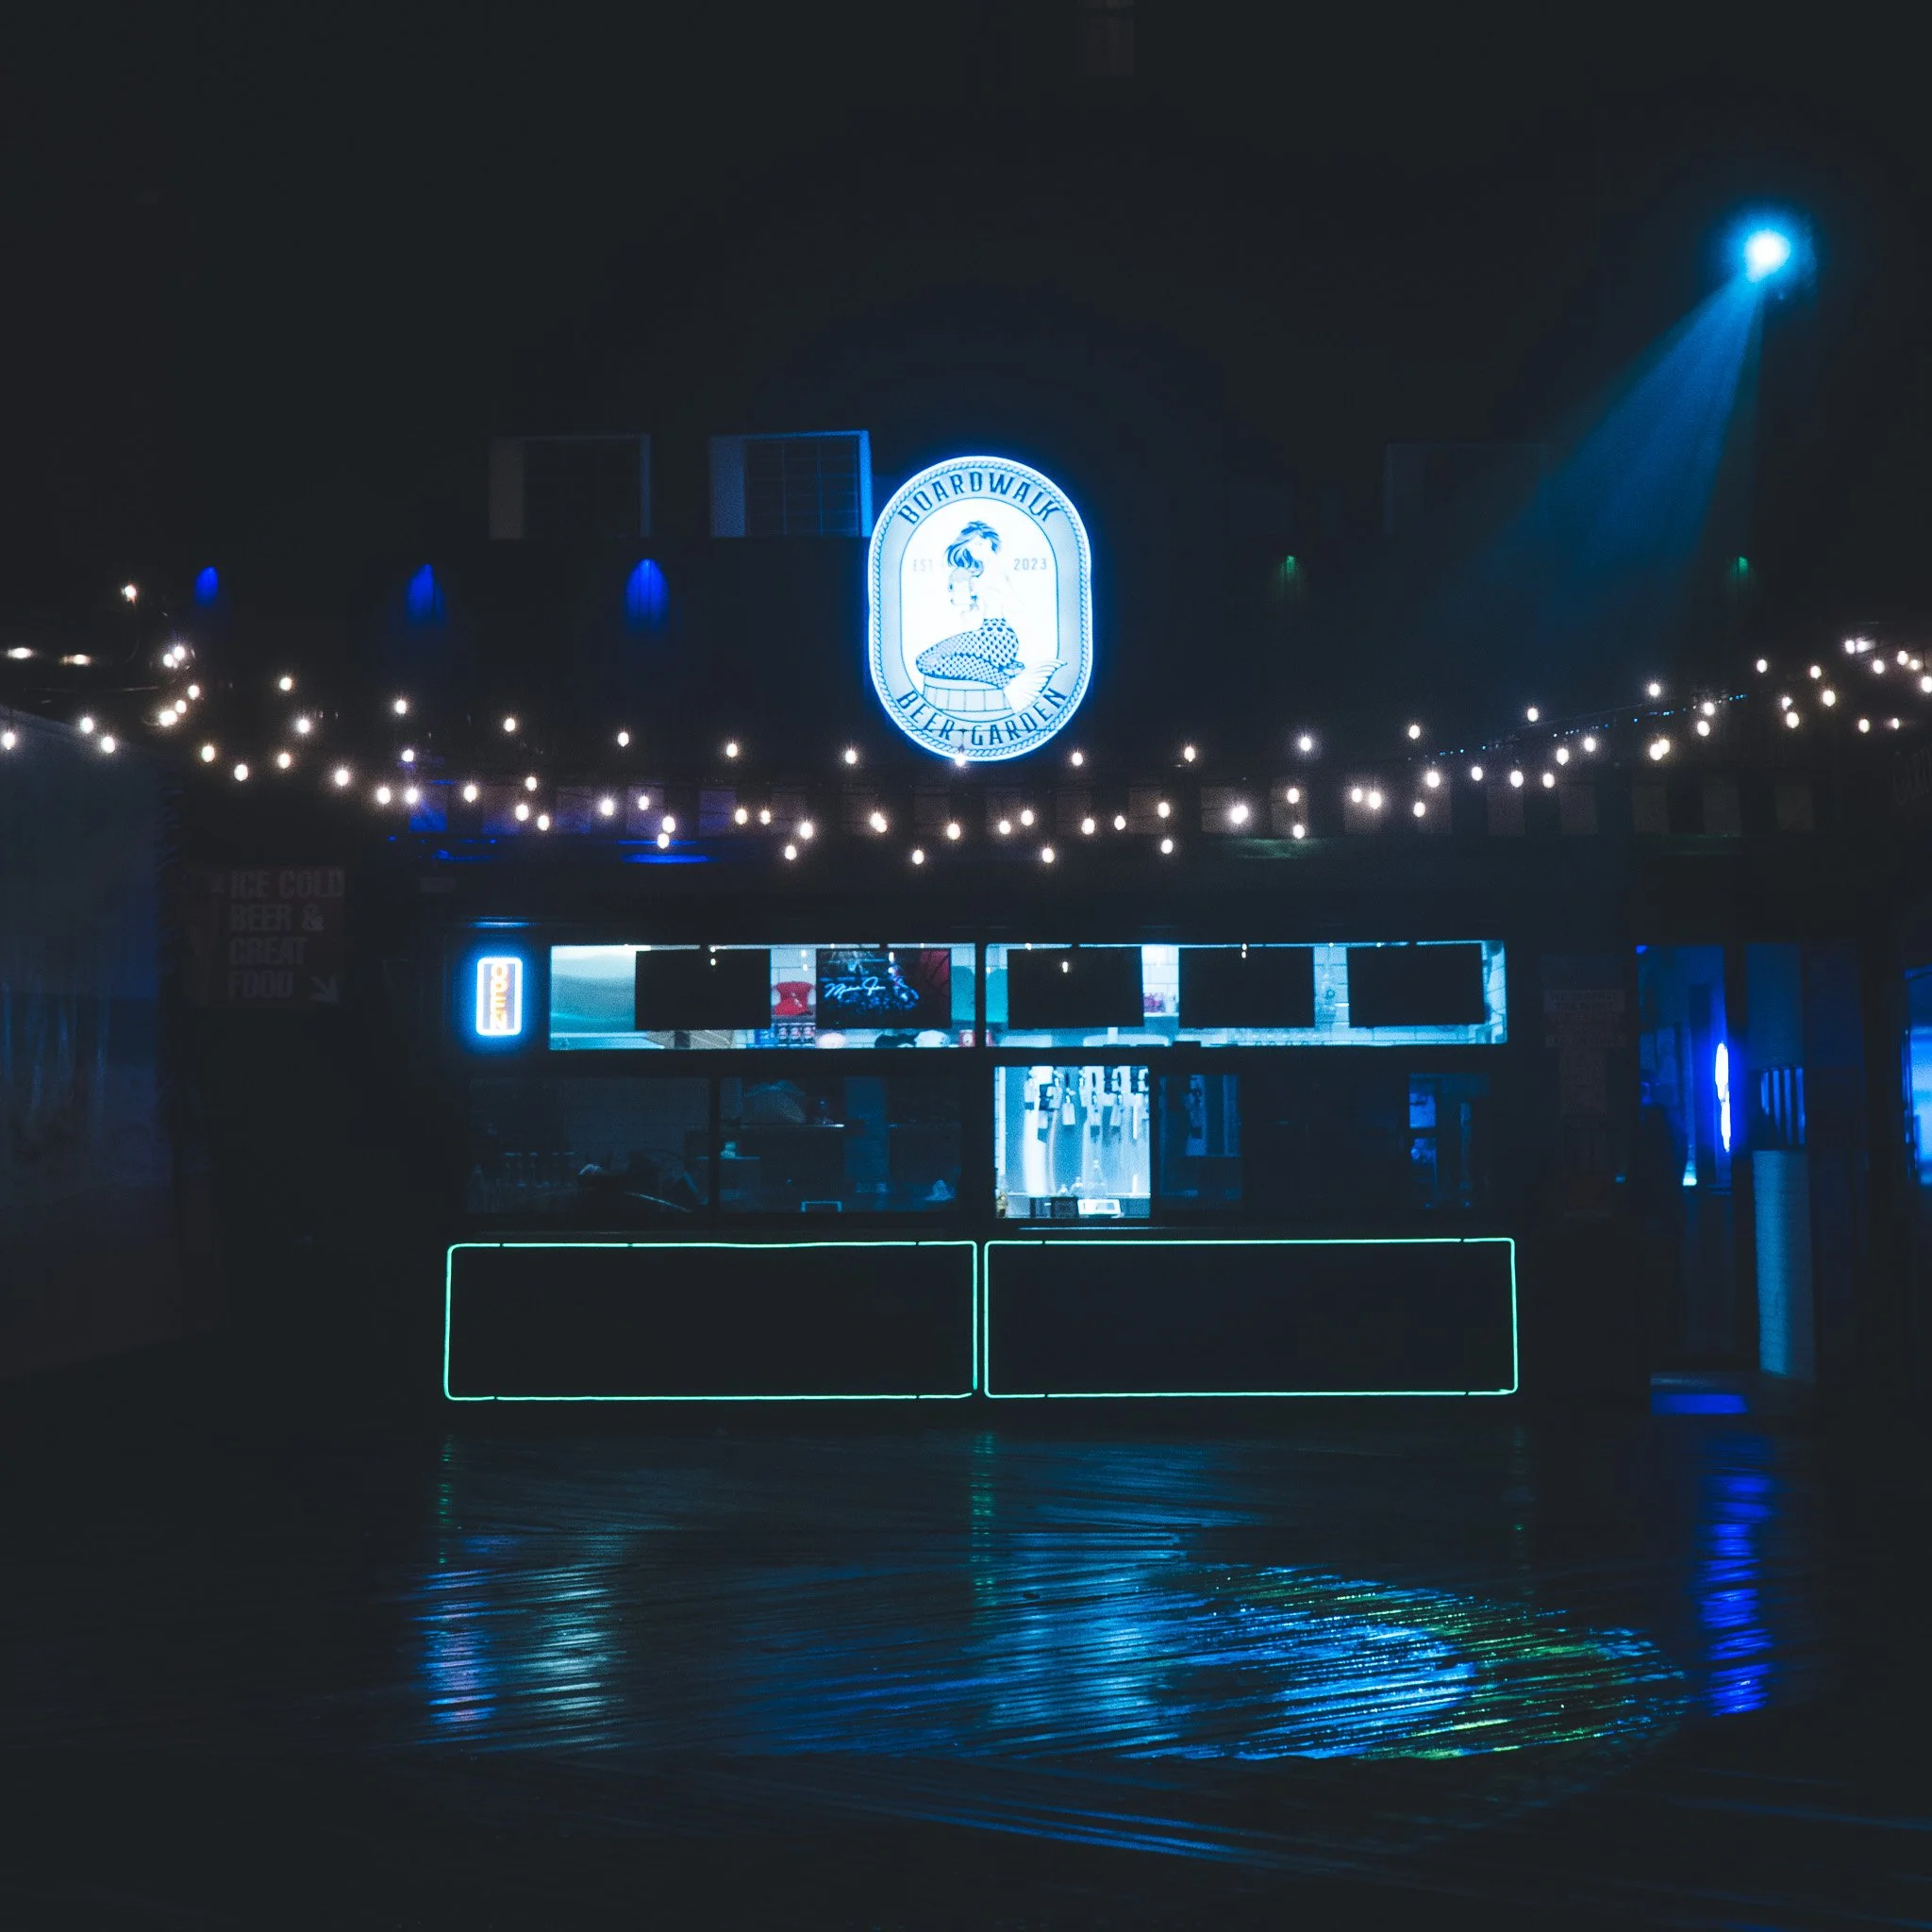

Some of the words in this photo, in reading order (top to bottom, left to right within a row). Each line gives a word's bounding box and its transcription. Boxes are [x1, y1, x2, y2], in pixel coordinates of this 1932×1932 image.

[897, 471, 1060, 525] BOARDWALK
[912, 558, 934, 572] EST
[1013, 558, 1047, 571] 2023
[896, 690, 956, 741] BEER
[970, 687, 1068, 746] GARDEN
[231, 870, 270, 899] ICE
[279, 868, 345, 898] COLD
[229, 904, 293, 932] BEER
[302, 903, 325, 931] &
[229, 936, 308, 966] GREAT
[227, 969, 294, 999] FOOD
[490, 962, 508, 1030] OPEN
